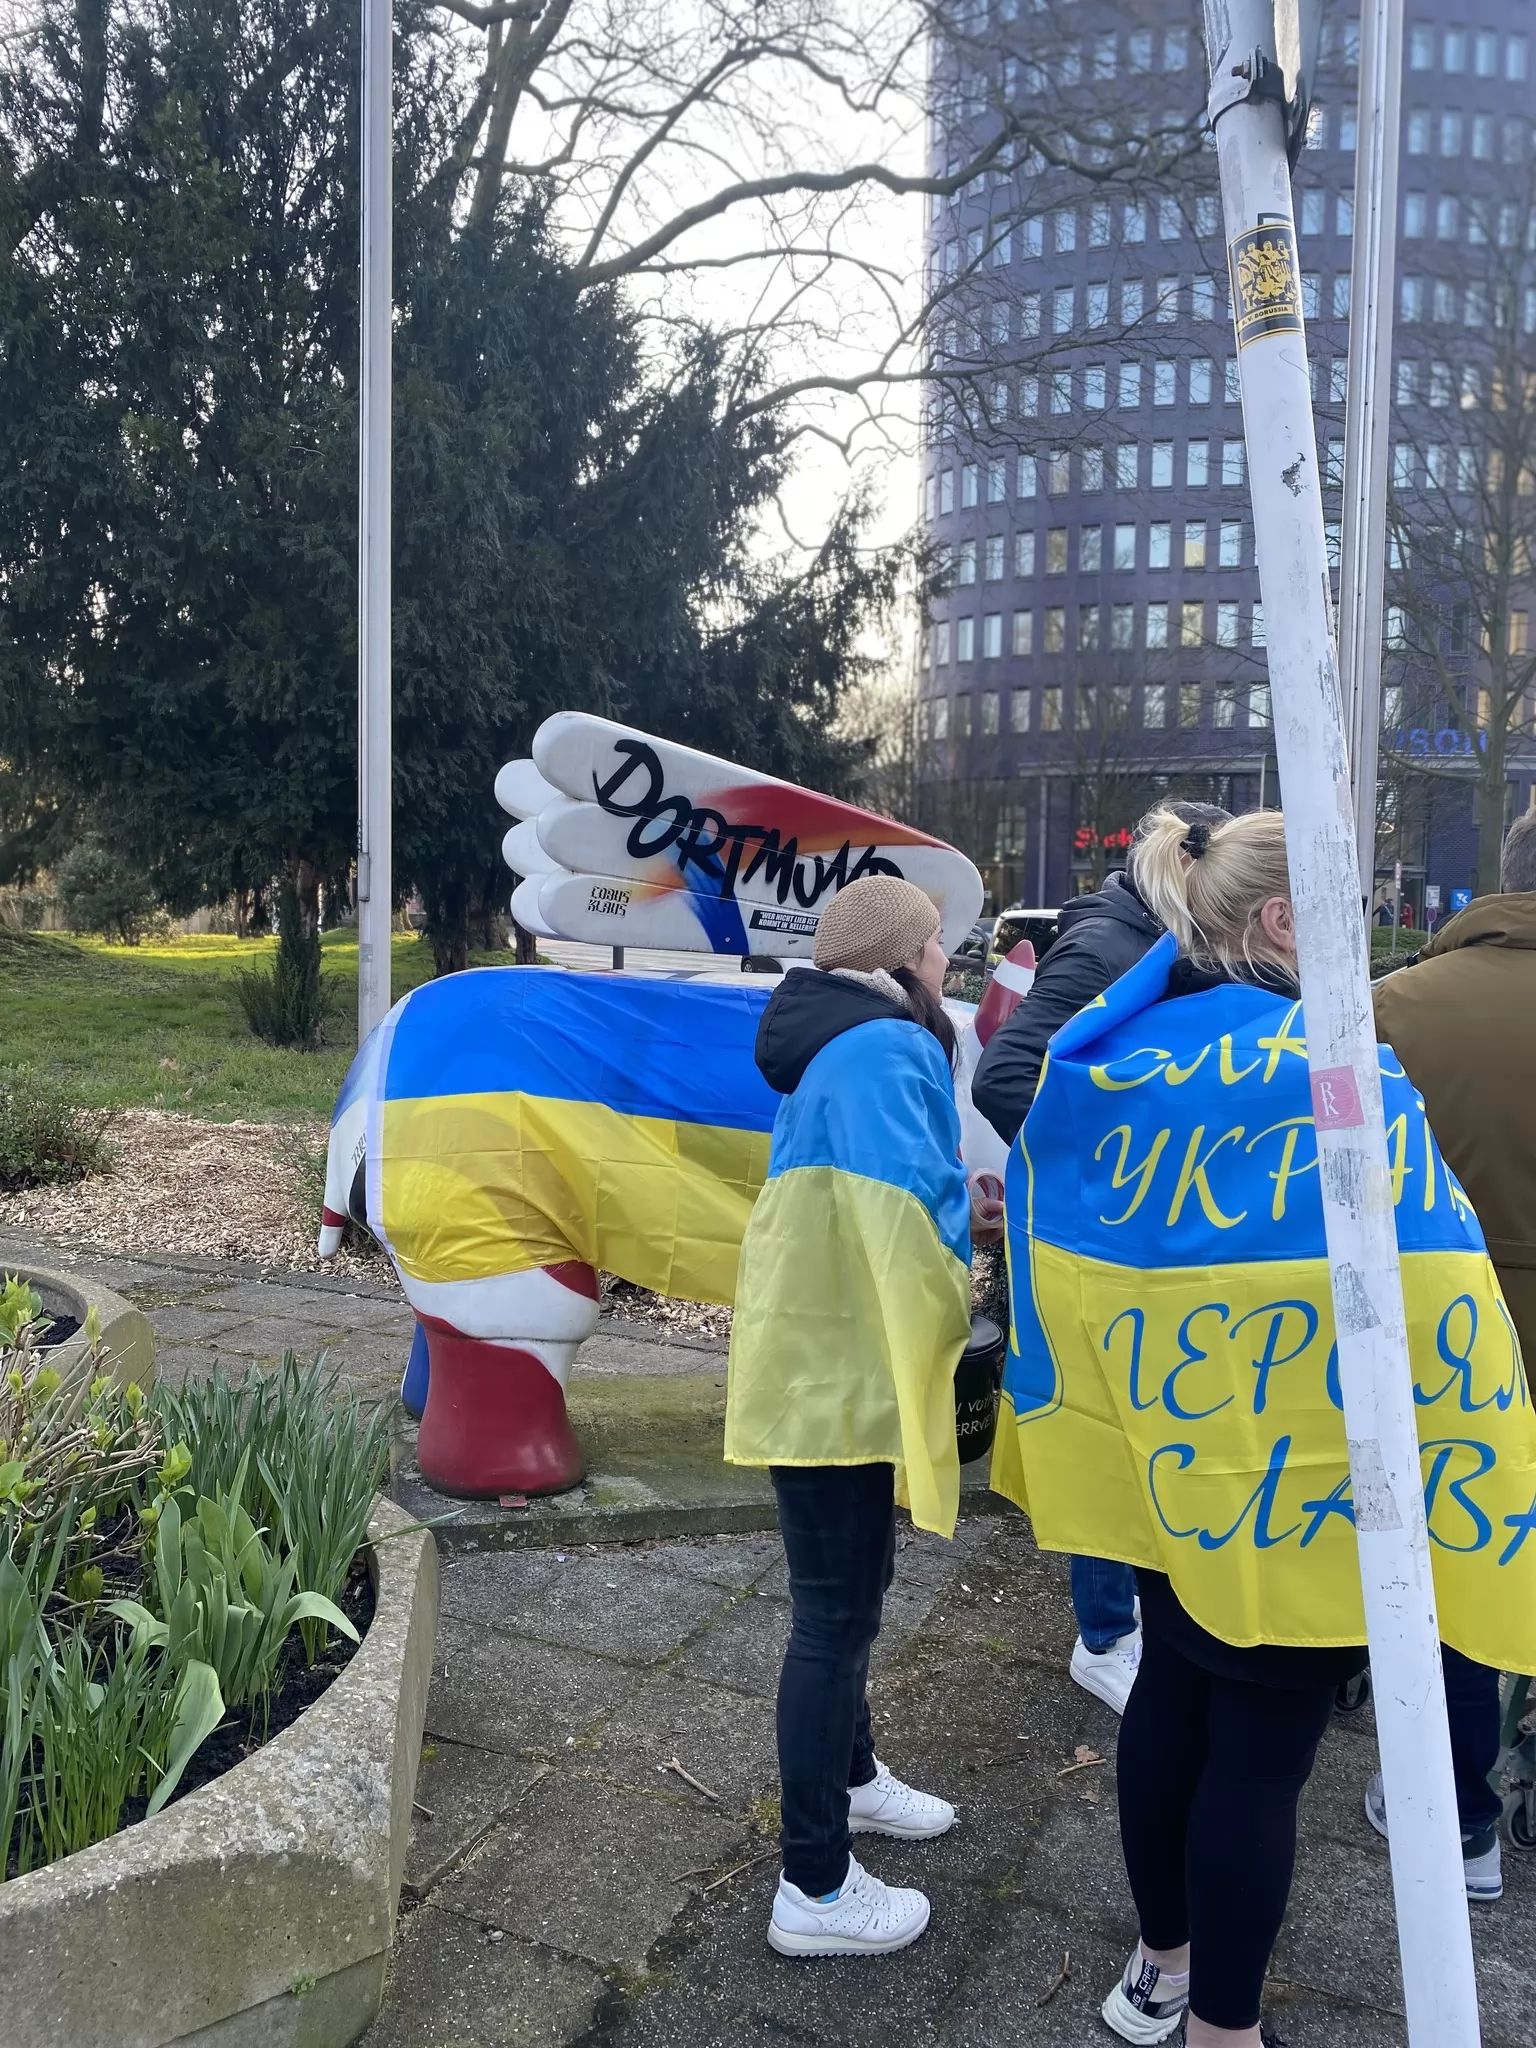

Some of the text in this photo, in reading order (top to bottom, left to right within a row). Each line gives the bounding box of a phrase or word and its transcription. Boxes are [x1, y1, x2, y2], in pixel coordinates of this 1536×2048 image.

[1254, 306, 1288, 318] BORUSSIA
[1456, 893, 1468, 904] TK
[758, 918, 781, 928] KOMMT
[776, 913, 794, 922] NICHT
[794, 915, 807, 924] LIEB
[807, 918, 818, 926] IST
